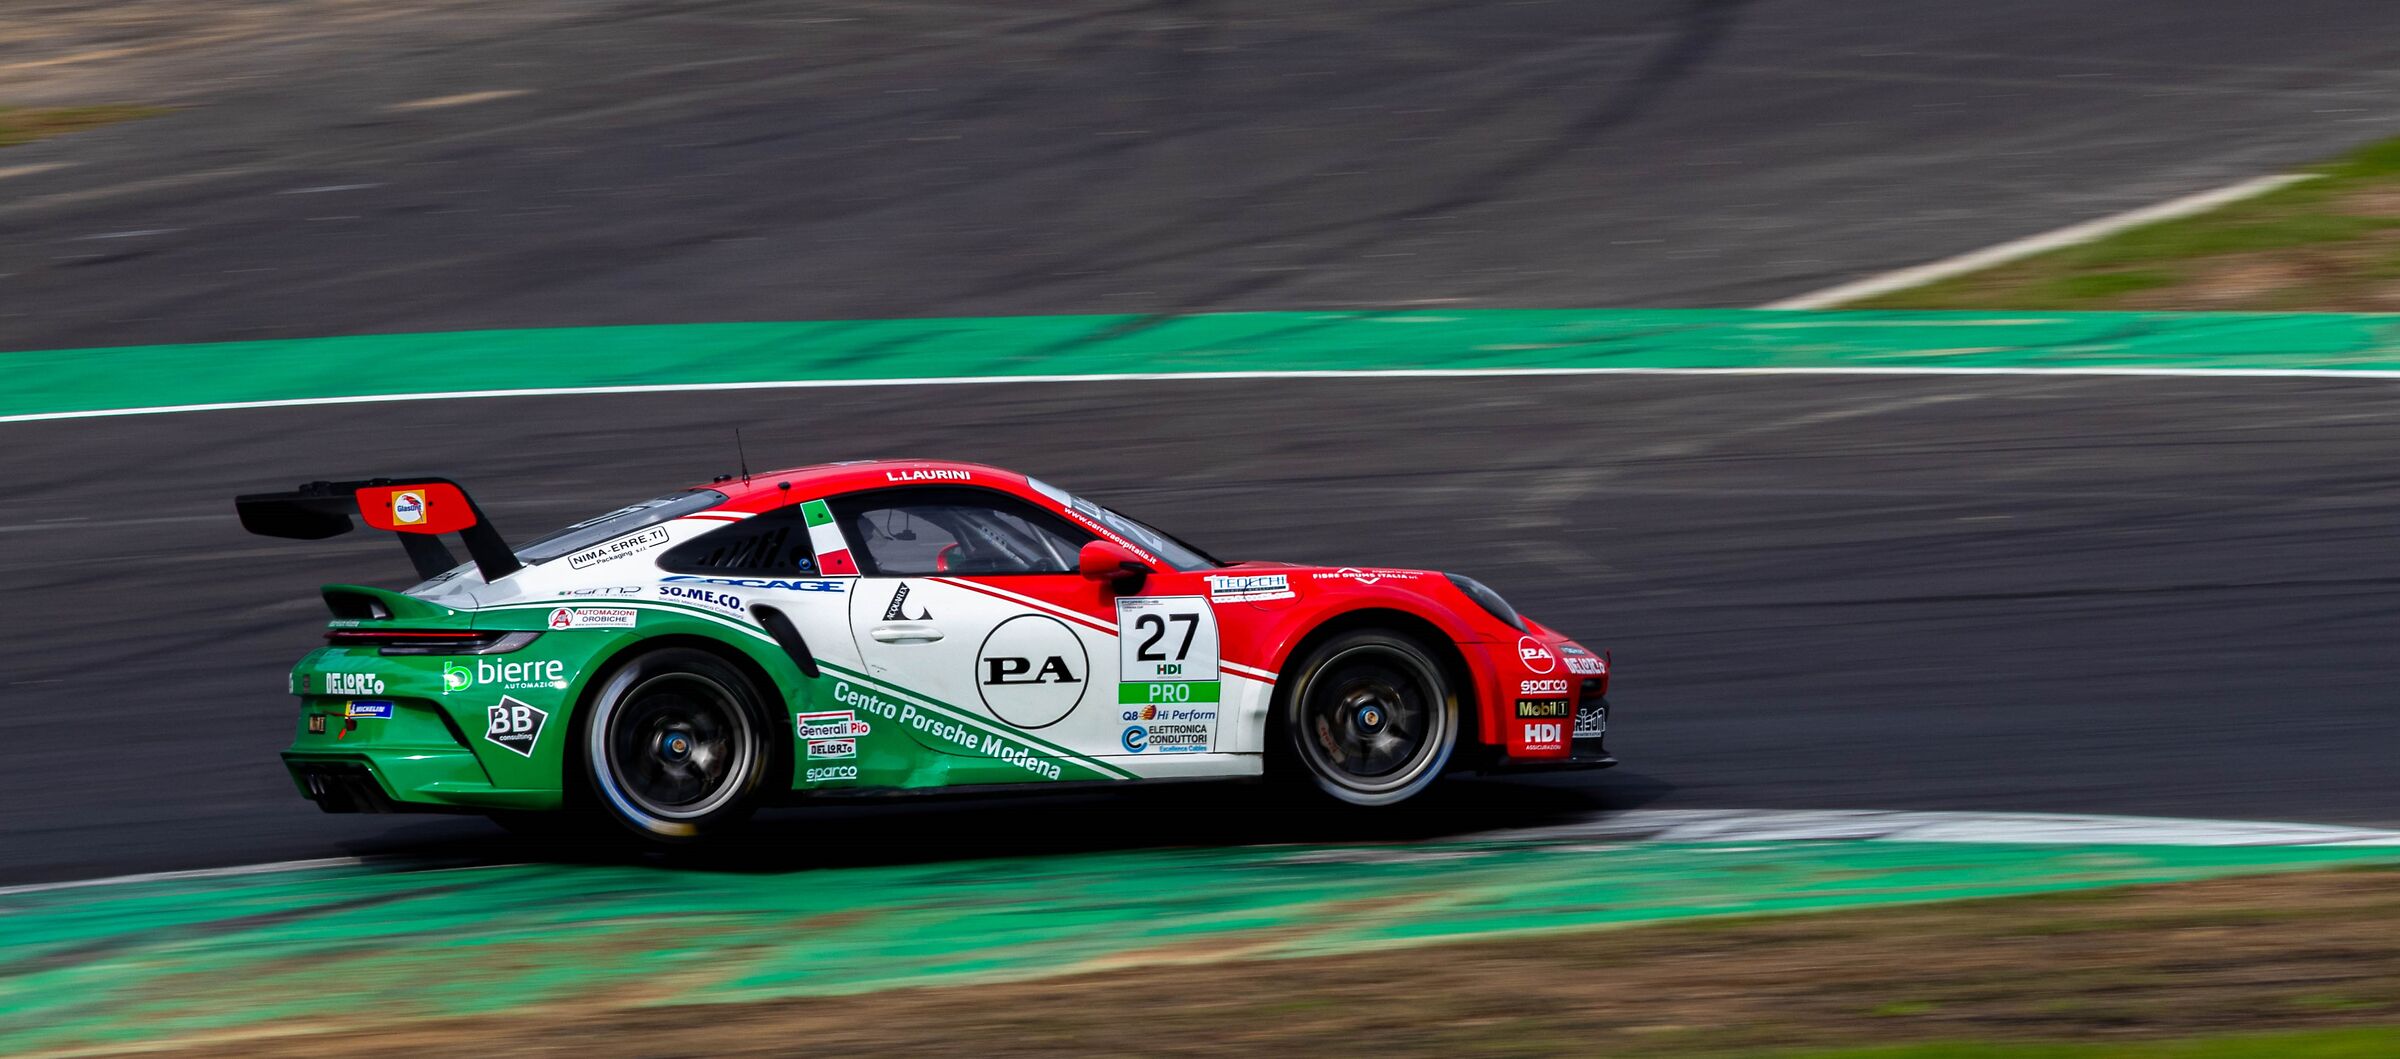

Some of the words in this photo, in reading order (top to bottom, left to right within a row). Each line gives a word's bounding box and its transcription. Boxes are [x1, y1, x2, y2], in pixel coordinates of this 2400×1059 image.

[886, 470, 971, 482] L.LAURINI
[1064, 506, 1158, 566] www.carreracupitalia.it
[573, 529, 664, 565] NIMA-ERRE.TI
[596, 549, 633, 564] Packaging
[659, 586, 745, 612] SO.ME.CO.
[1135, 613, 1200, 662] 27
[1521, 648, 1552, 660] PA
[478, 657, 563, 684] bierre
[983, 656, 1081, 685] PA
[1156, 664, 1182, 675] HDI
[1149, 683, 1190, 702] PRO
[1520, 680, 1568, 695] sparco
[1122, 711, 1139, 721] Q8
[1157, 711, 1169, 720] Hi
[1172, 709, 1216, 721] Perform
[1520, 701, 1557, 716] Mobil
[491, 706, 534, 734] BB
[800, 724, 848, 737] Generali
[851, 722, 869, 734] Pio
[833, 681, 897, 720] Centro
[899, 704, 979, 749] Porsche
[980, 735, 1062, 781] Modena
[1149, 724, 1208, 734] ELETTRONICA
[1524, 724, 1561, 743] HDI
[499, 733, 533, 741] consulting
[1149, 735, 1208, 744] CONDUTTORI
[811, 743, 853, 755] DELLORTO
[806, 766, 858, 782] sparco
